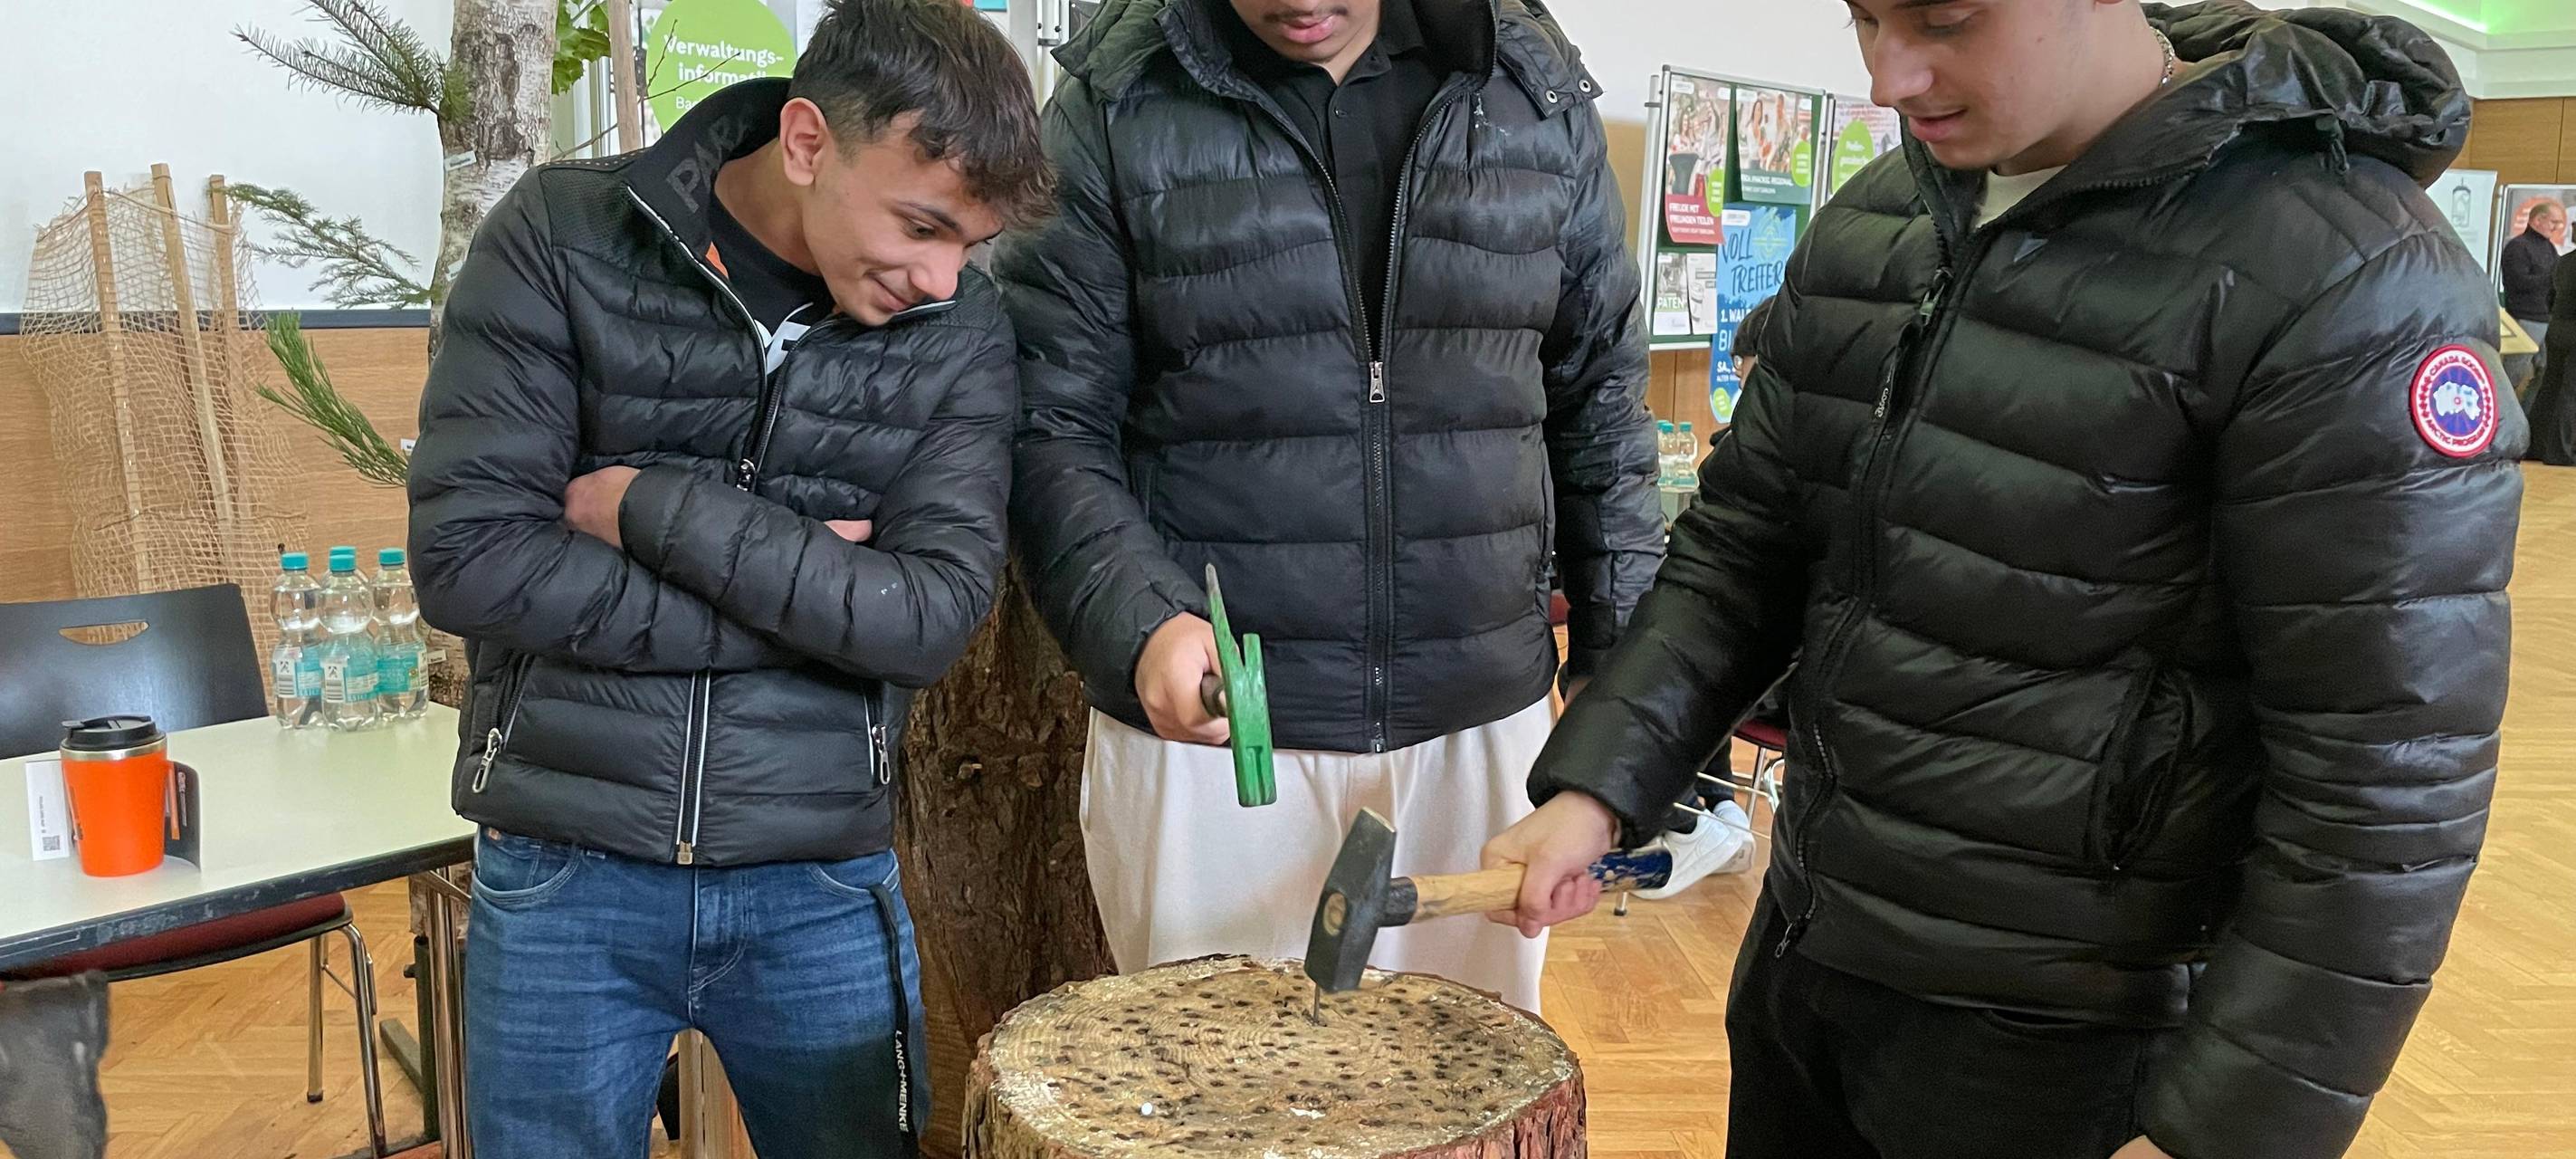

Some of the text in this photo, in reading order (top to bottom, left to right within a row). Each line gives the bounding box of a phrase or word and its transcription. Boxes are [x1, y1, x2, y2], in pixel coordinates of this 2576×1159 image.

[663, 34, 784, 68] Verwaltungs-
[1722, 228, 1752, 263] VOLL
[1657, 297, 1684, 309] PATEN
[2430, 356, 2459, 376] CANADA
[2427, 419, 2451, 444] ARCTIC
